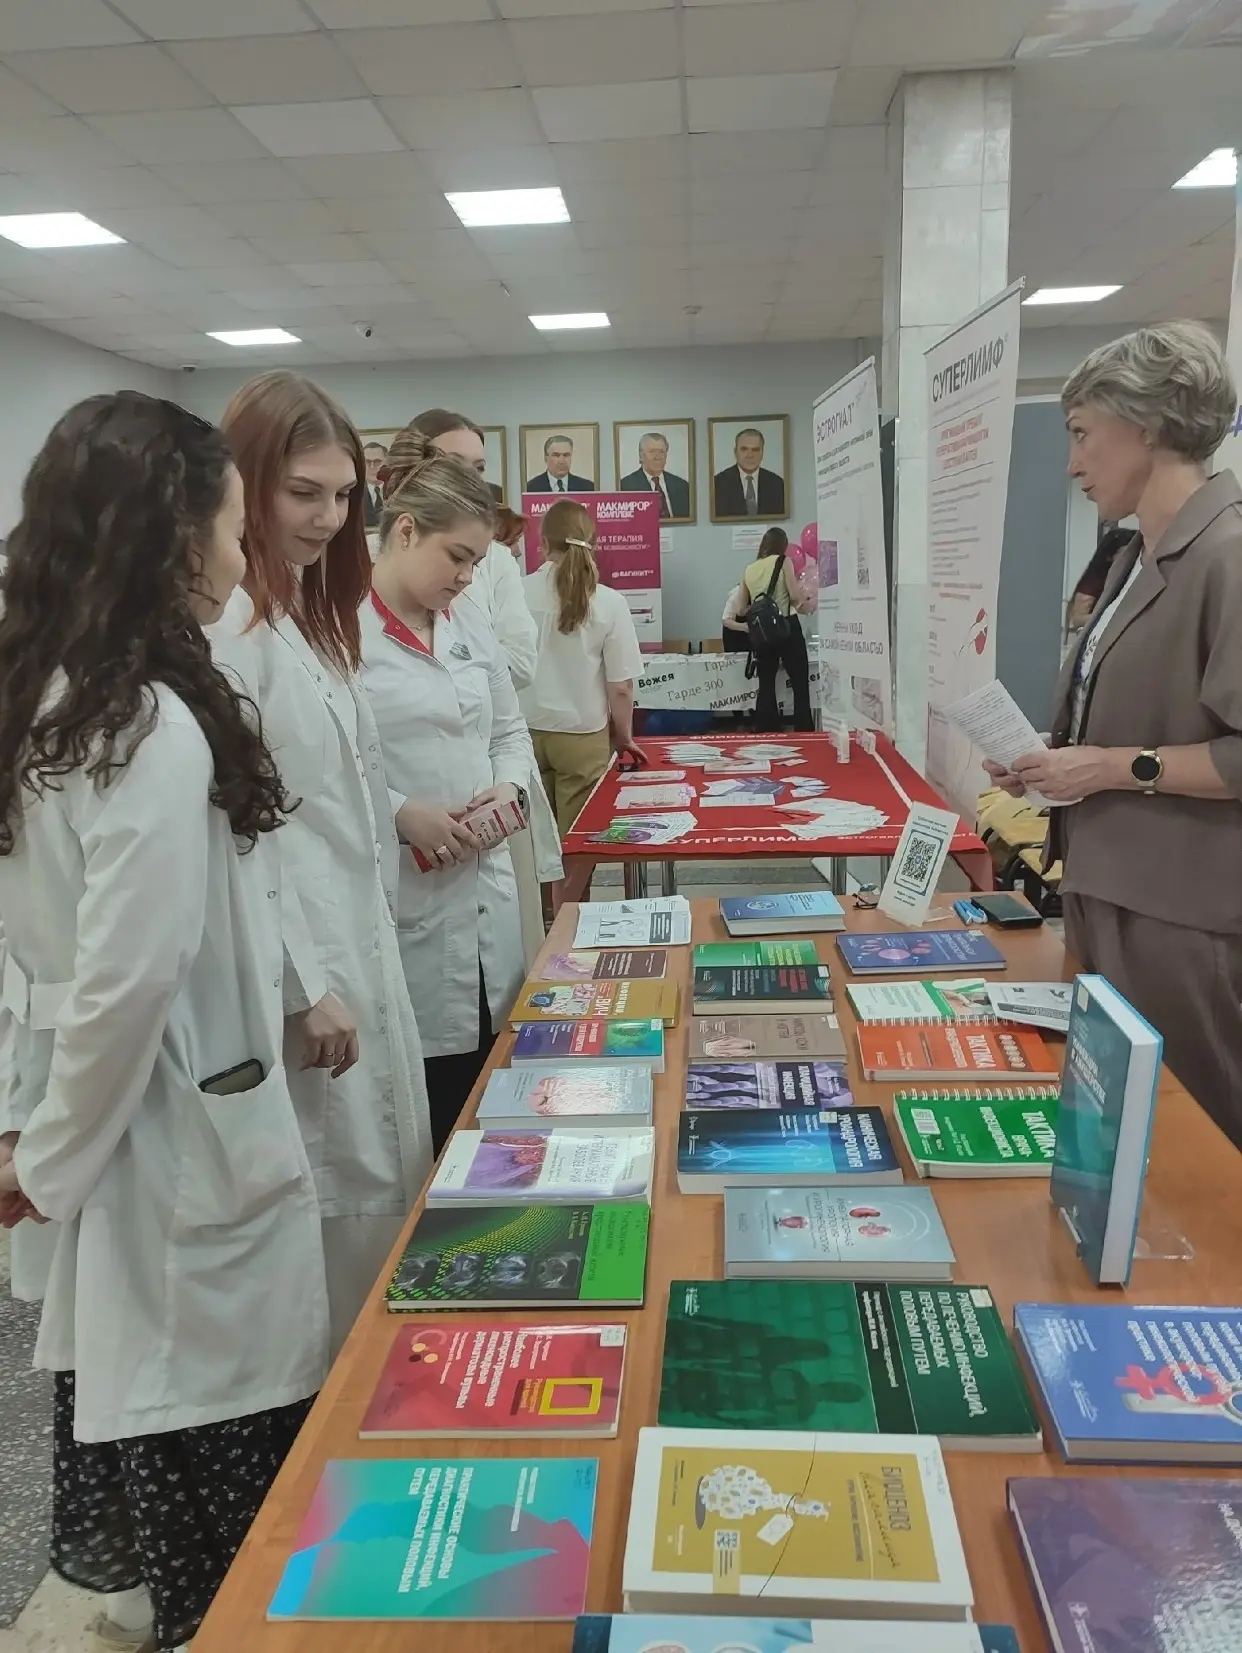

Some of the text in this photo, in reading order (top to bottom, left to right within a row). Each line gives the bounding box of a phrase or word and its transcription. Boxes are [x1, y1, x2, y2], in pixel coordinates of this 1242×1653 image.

[932, 336, 1004, 402] СУПЕРЛИМФ
[597, 501, 650, 512] МАКМИРОР
[597, 511, 634, 519] КОМПЛЕКС
[609, 535, 643, 543] ТЕРАПИЯ
[638, 672, 675, 688] Вожея
[667, 686, 702, 702] Гарде
[705, 678, 724, 693] 300
[591, 998, 611, 1015] ВИЧ
[966, 1035, 997, 1068] ТАКТИКА
[839, 1114, 863, 1168] УРОАНДРОЛОГИЯ
[857, 1113, 882, 1160] КЛИНИЧЕСКАЯ
[1022, 1111, 1055, 1158] ТАКТИКА
[510, 1331, 528, 1368] Наиболее
[900, 1291, 931, 1375] ПОЛОВЫМ ПУТЕМ
[918, 1291, 950, 1369] ПЕРЕДАВАЕМЫХ
[956, 1291, 988, 1358] РУКОВОДСТВО
[456, 1331, 487, 1408] дерматозы вульвы
[937, 1291, 988, 1418] ПО ЛЕЧЕНИЮ ИНФЕКЦИЙ,
[408, 1467, 426, 1495] ПУТЕМ
[880, 1466, 912, 1531] БИОЦЕНОЗ
[398, 1467, 441, 1593] ПЕРЕДАВАЕМЫХ ПОЛОВЫМ
[415, 1467, 458, 1590] ДИАГНОСТИКИ ИНФЕКЦИЙ,
[438, 1467, 474, 1579] ПРАКТИЧЕСКИЕ ОСНОВЫ
